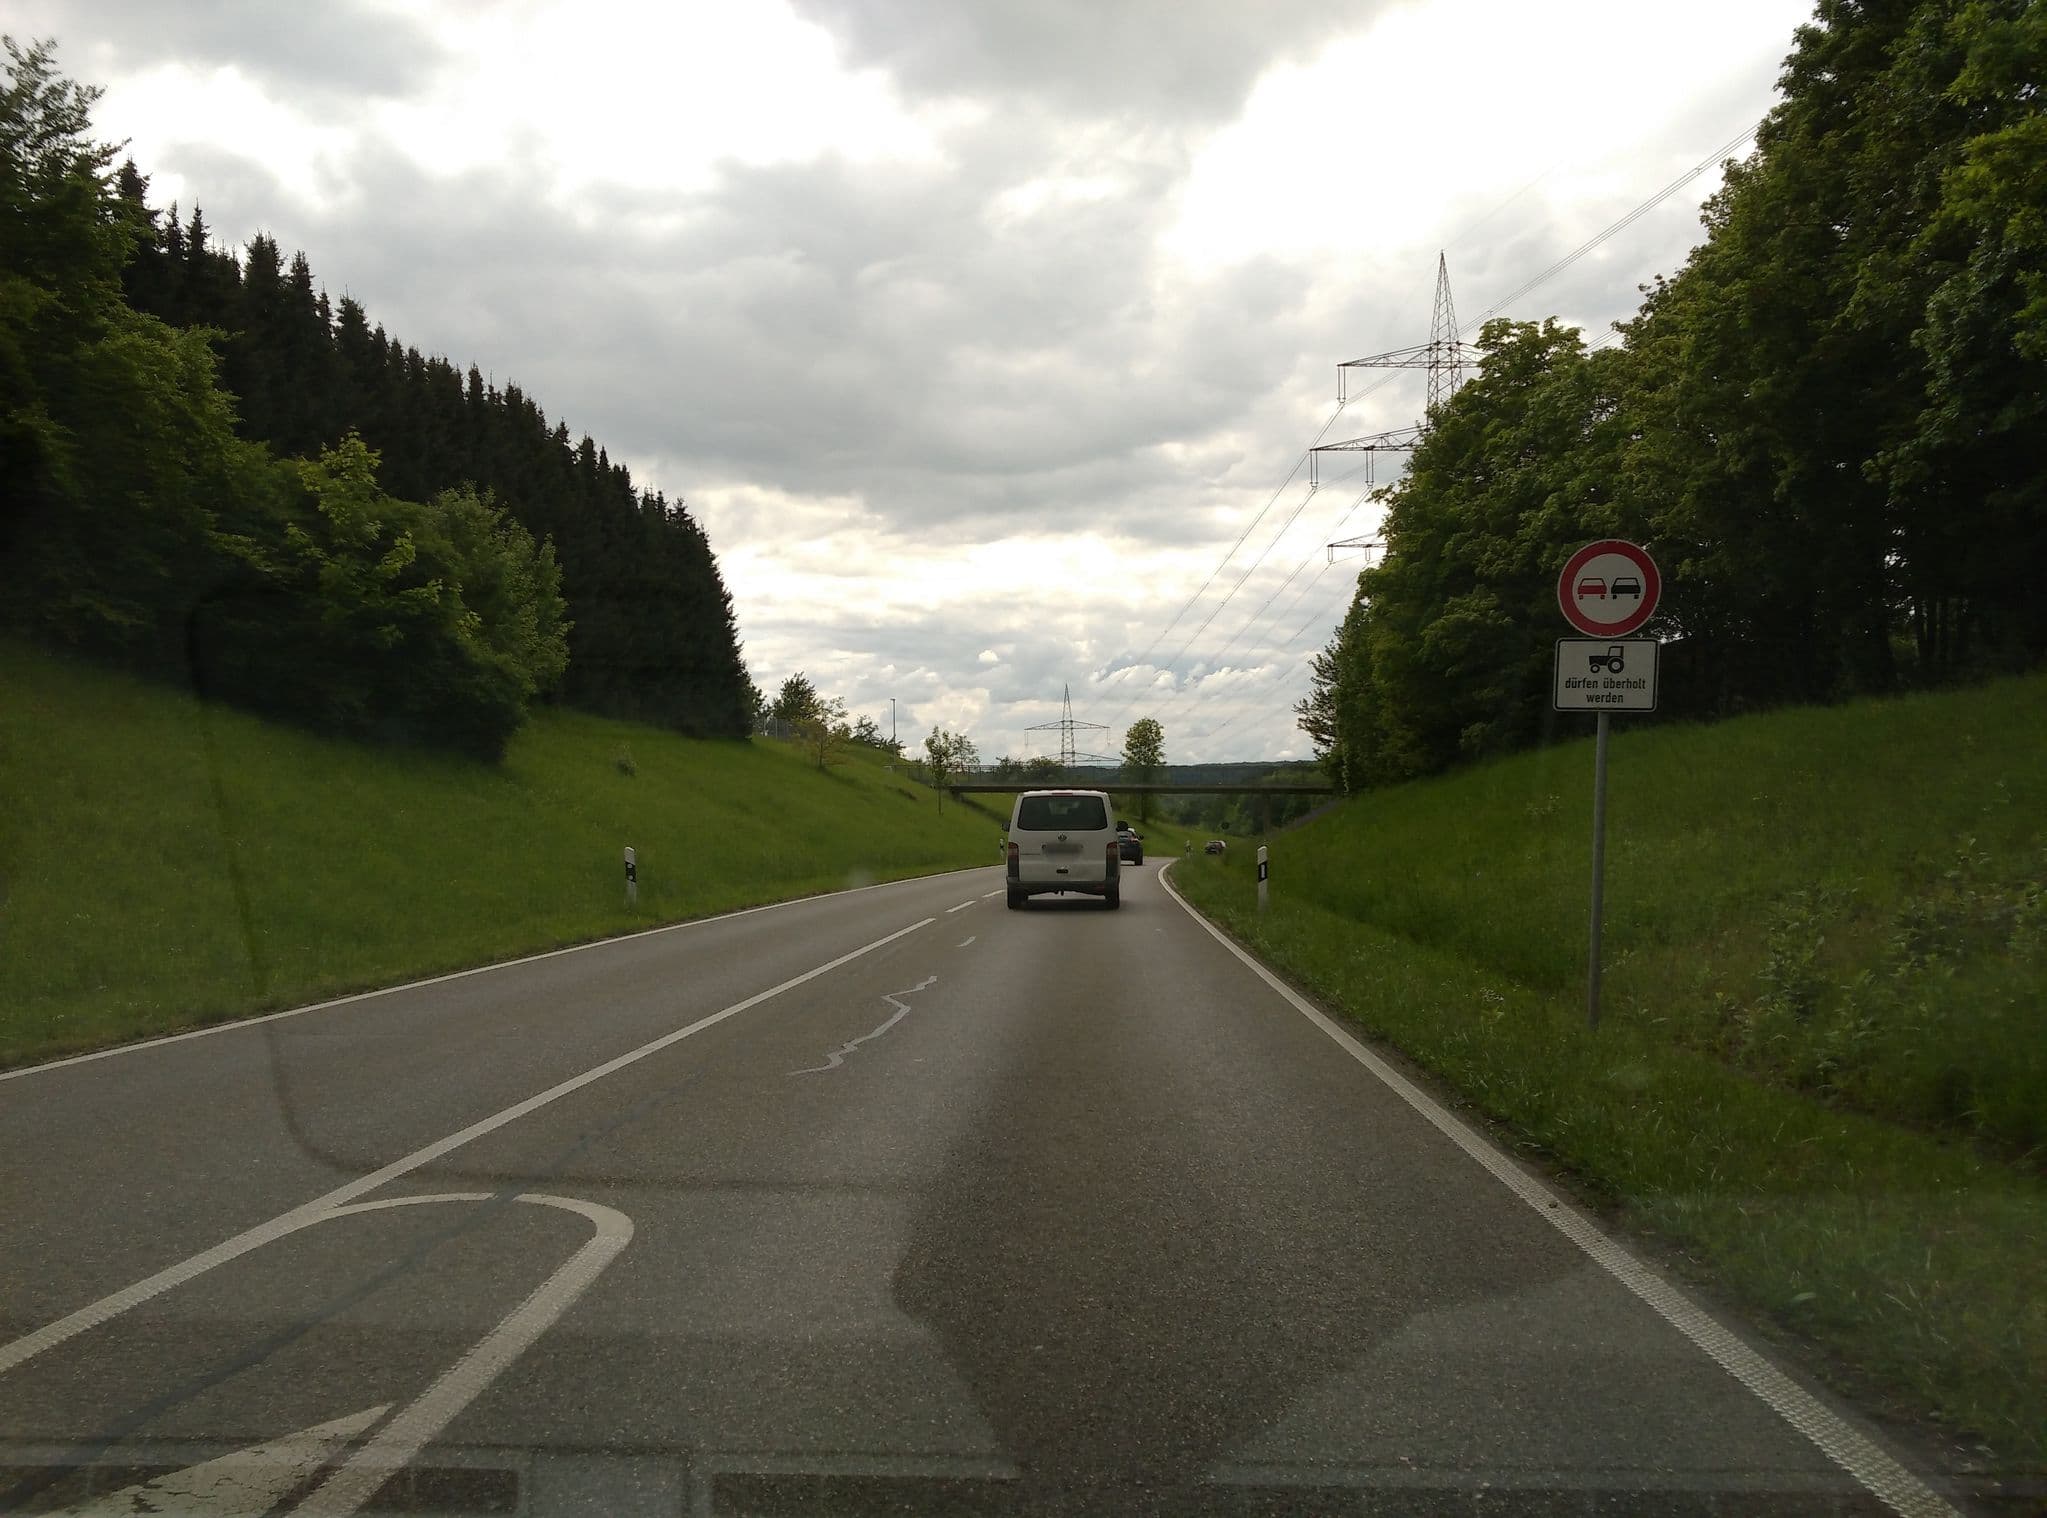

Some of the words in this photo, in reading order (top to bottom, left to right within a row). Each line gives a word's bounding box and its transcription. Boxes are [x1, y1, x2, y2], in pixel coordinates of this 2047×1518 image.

[1565, 677, 1599, 689] dürfen
[1603, 677, 1646, 689] überholt
[1586, 692, 1624, 703] werden
